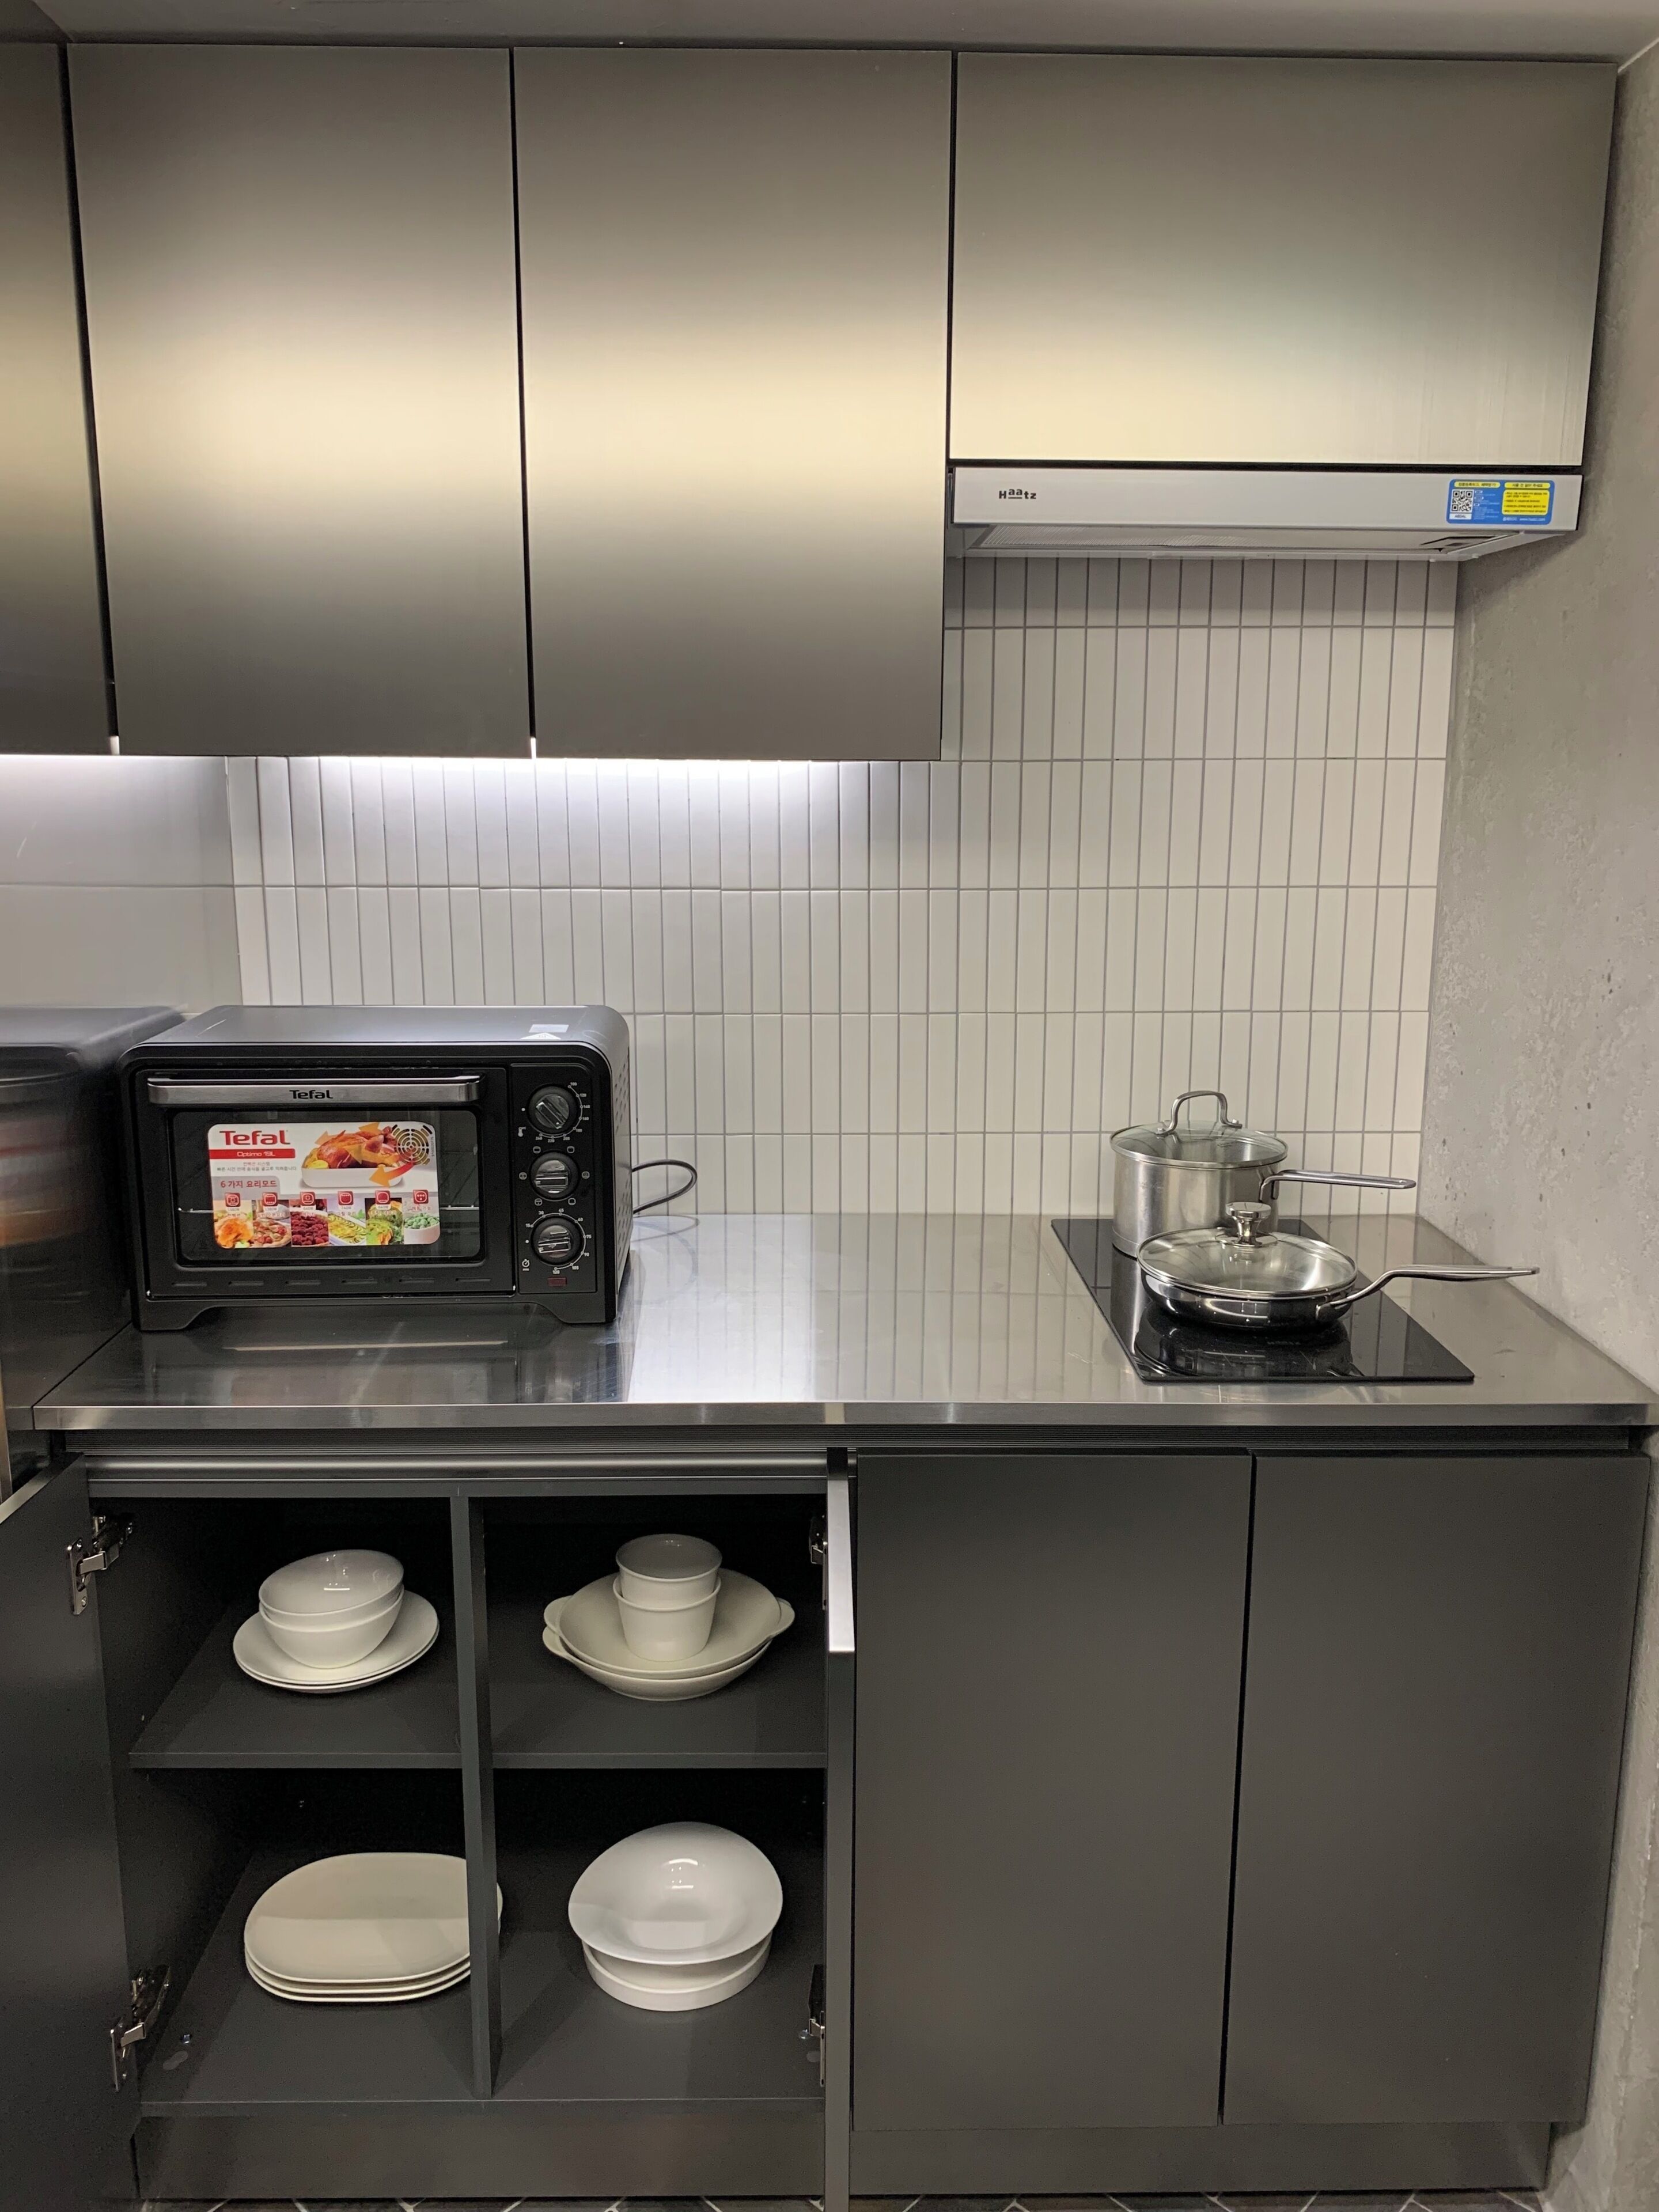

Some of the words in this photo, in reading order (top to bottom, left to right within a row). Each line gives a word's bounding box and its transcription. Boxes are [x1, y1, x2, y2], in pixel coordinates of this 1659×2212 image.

[999, 489, 1037, 499] Haatz
[289, 1090, 334, 1099] Tefal
[219, 1130, 291, 1145] Tefal
[228, 1180, 243, 1188] 가지
